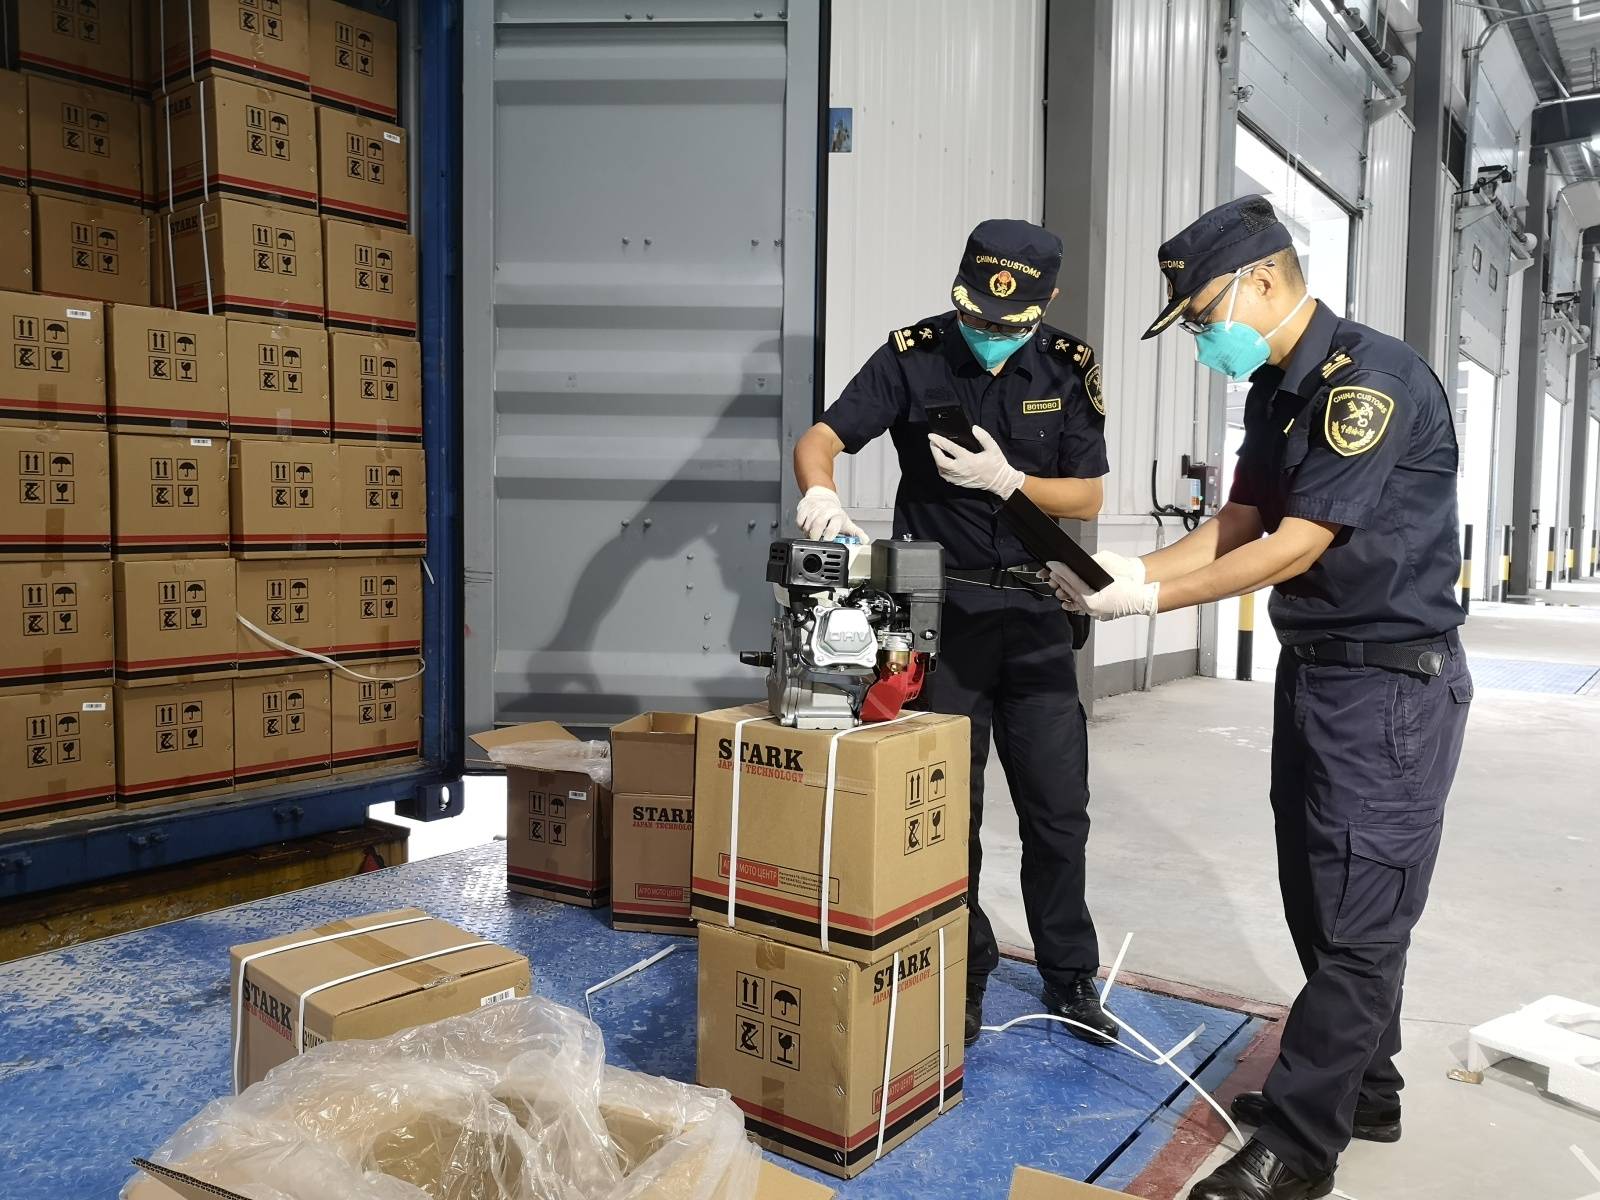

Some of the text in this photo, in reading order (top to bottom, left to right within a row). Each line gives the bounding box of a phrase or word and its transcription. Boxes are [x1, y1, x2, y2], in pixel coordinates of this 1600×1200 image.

[976, 256, 1041, 278] CHINA CUSTOMS
[1026, 402, 1057, 411] 8011080
[1333, 392, 1388, 414] CHINA CUSTOMS
[719, 738, 804, 772] STARK
[718, 760, 804, 783] JAP TECHNOLOGY
[633, 821, 692, 831] JAPAN TECHNOLO
[740, 863, 757, 876] МОТО
[757, 867, 777, 881] ЦЕНТР
[874, 947, 931, 994] STARK
[243, 977, 292, 1031] STARK
